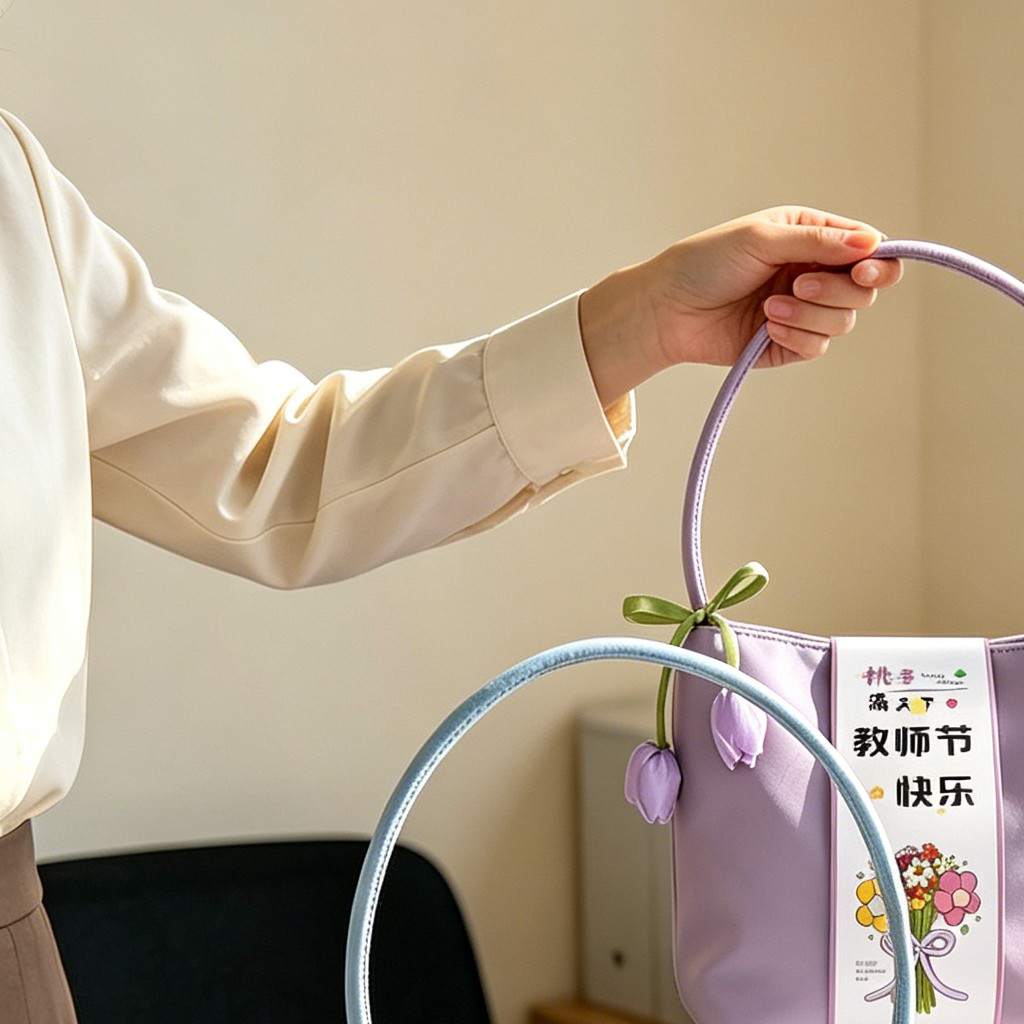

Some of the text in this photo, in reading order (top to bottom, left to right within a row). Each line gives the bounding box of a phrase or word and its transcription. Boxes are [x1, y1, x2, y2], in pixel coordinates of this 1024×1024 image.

[853, 724, 972, 757] 教师节
[896, 775, 975, 808] 快乐
